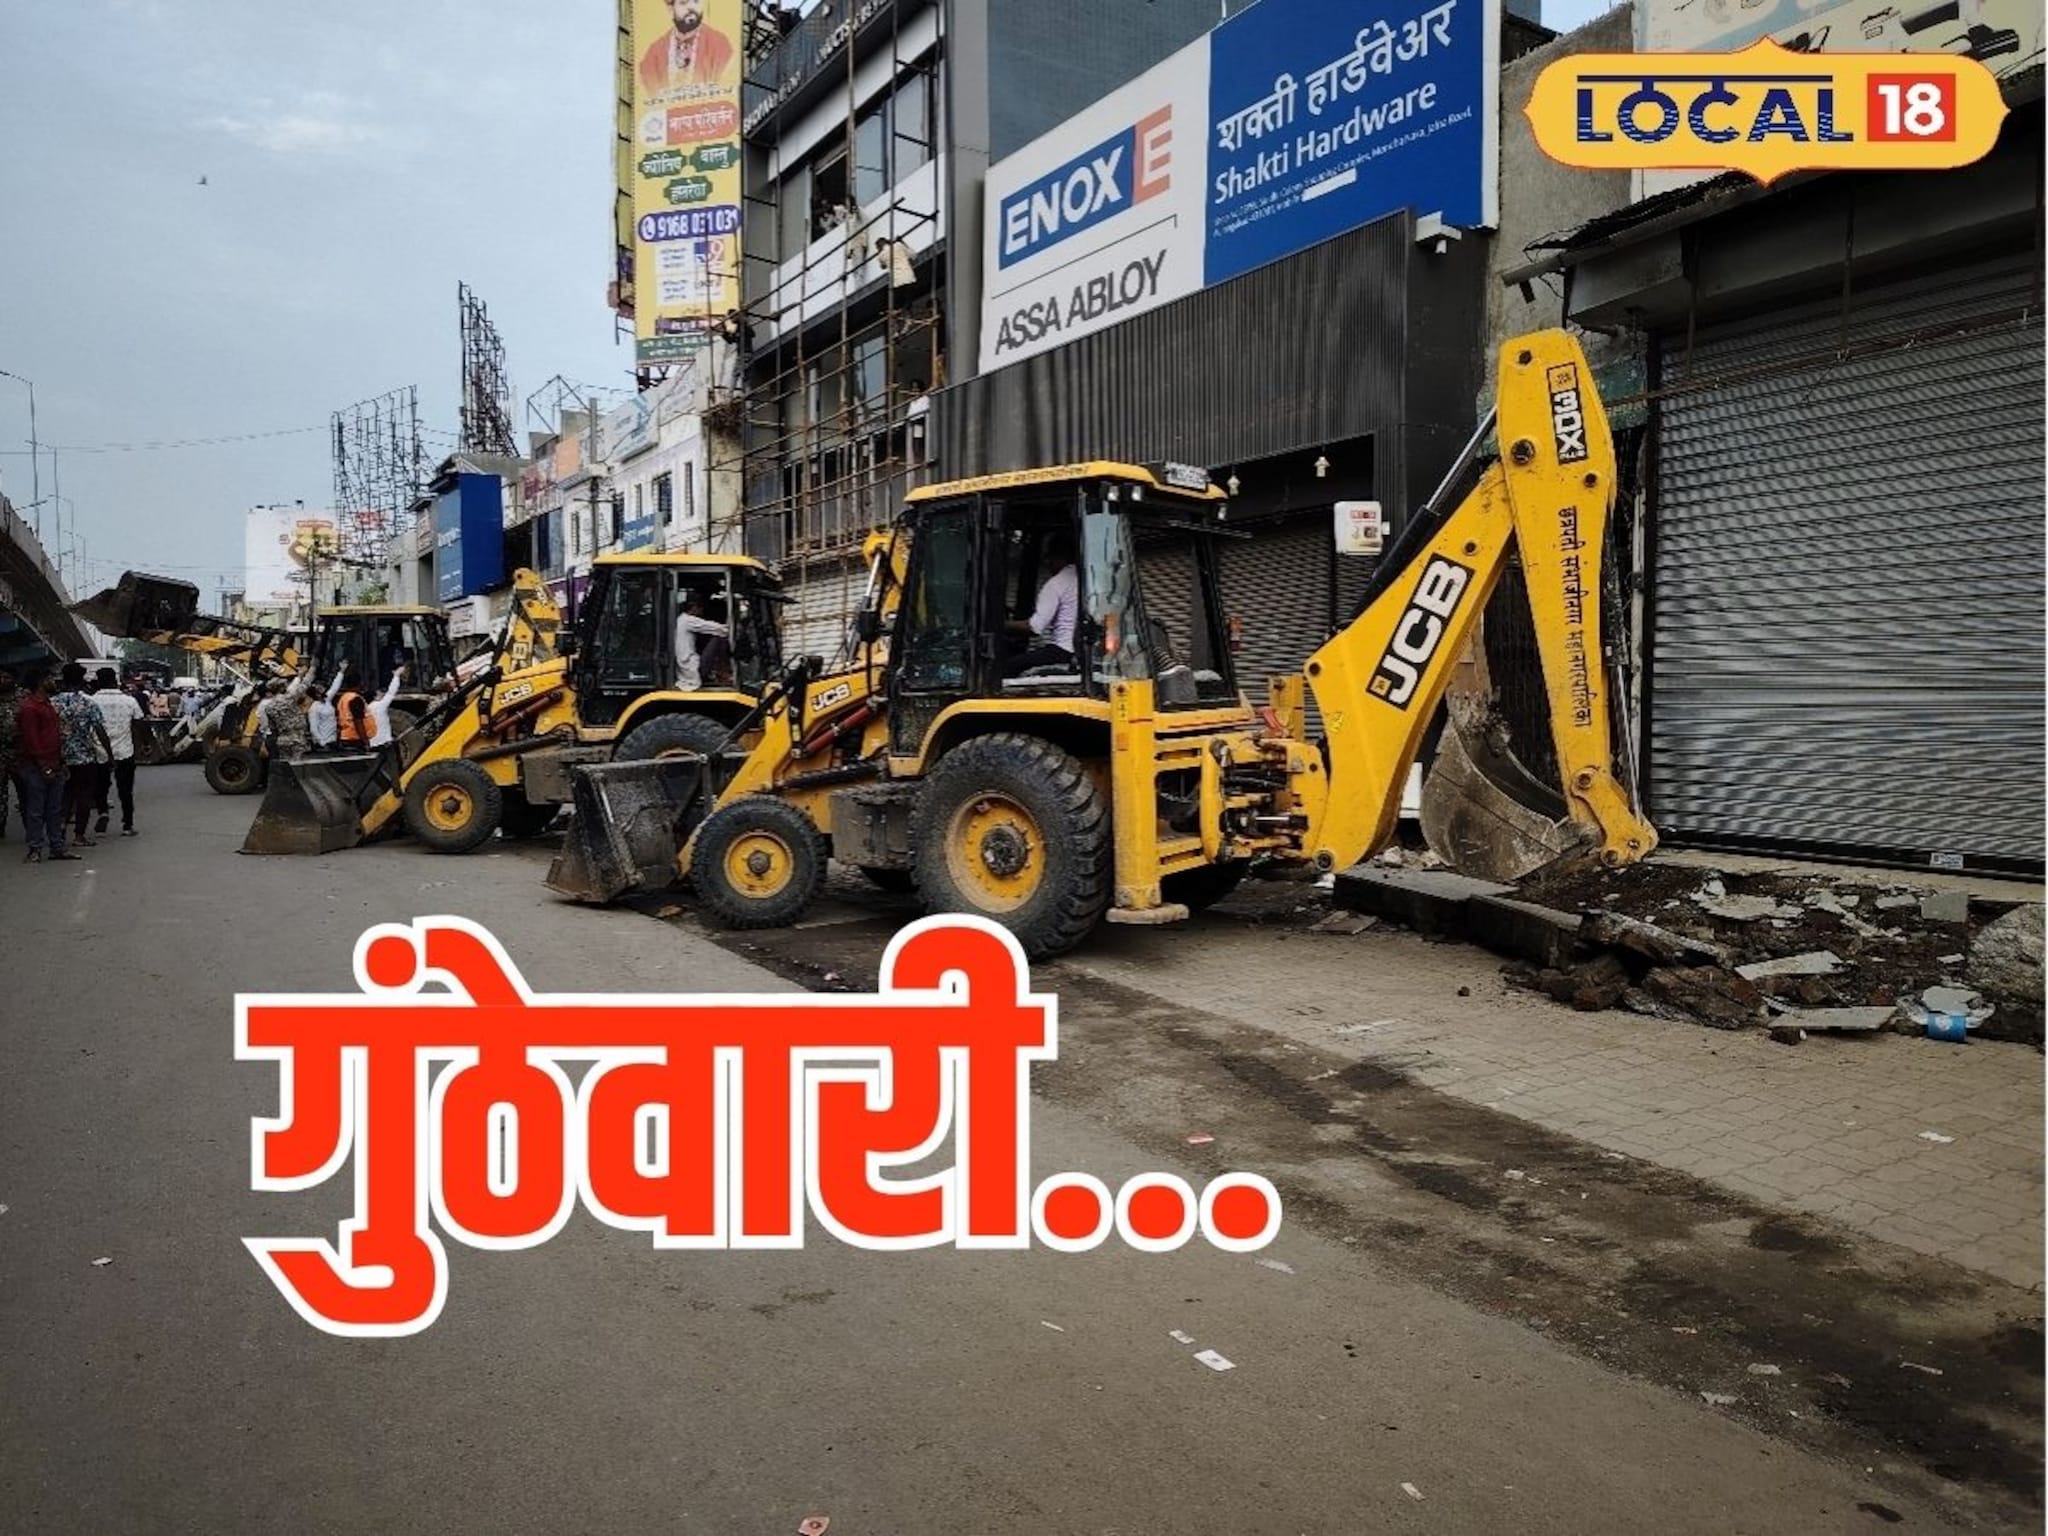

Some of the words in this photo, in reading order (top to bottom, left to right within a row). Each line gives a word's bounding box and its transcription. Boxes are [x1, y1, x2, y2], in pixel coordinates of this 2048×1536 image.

[1216, 72, 1298, 152] शक्ती
[1305, 2, 1457, 116] हार्डवेअर
[1215, 143, 1289, 205] Shakti
[1296, 82, 1437, 168] Hardware
[658, 214, 689, 239] 9168
[1005, 145, 1125, 256] ENOX
[995, 296, 1062, 356] ASSA
[1065, 248, 1168, 328] ABLOY
[1553, 390, 1586, 454] 3DX
[1557, 504, 1586, 551] छत्रपती
[1380, 560, 1468, 705] JCB
[501, 682, 533, 704] JCB
[812, 683, 850, 710] JCB
